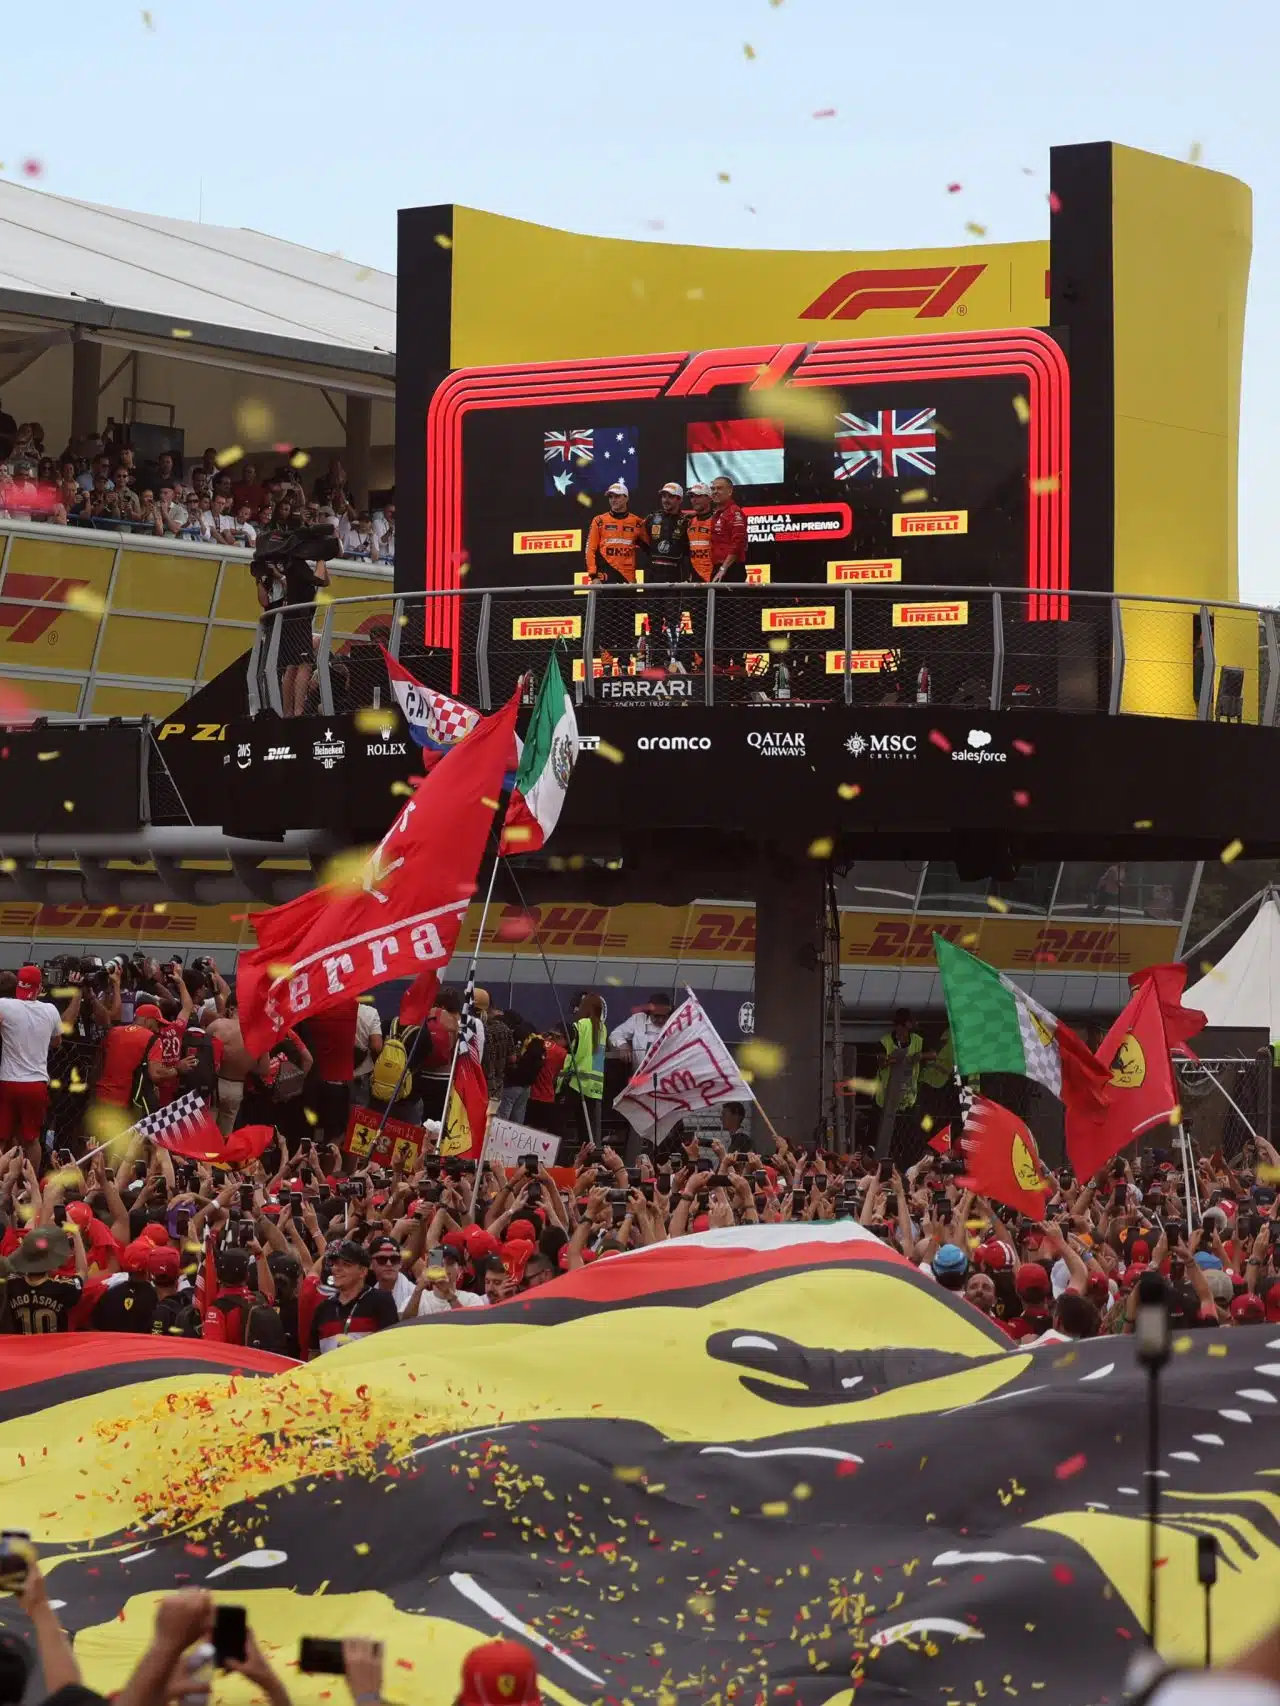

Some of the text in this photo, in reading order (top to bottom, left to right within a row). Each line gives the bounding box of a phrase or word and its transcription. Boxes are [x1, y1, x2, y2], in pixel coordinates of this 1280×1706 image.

[797, 263, 988, 320] F1
[746, 521, 840, 533] ELLI GRAN PREMIO
[747, 515, 784, 525] RMULA
[901, 515, 959, 532] PIRELLI
[521, 533, 574, 551] PIRELLI
[747, 533, 775, 542] TALIA
[835, 562, 893, 580] PIRELLI
[770, 610, 827, 627] PIRELLI
[901, 604, 960, 623] PIRELLI
[521, 620, 574, 636] PIRELLI
[602, 680, 693, 698] FERRARI
[158, 724, 185, 741] P
[747, 732, 806, 748] QATAR
[237, 743, 251, 757] aws
[314, 745, 344, 755] Heineken
[367, 743, 406, 756] ROLEX
[637, 736, 711, 750] aramco
[870, 735, 917, 752] MSC
[264, 747, 296, 761] DHL
[761, 747, 806, 757] AIRWAYS
[951, 750, 1007, 764] salesforce
[491, 905, 608, 945] DHL
[686, 914, 756, 951] DH
[1026, 929, 1118, 963] DHL
[163, 1037, 180, 1056] 20
[10, 1294, 64, 1313] IAGO ASPAS
[17, 1307, 57, 1336] 10
